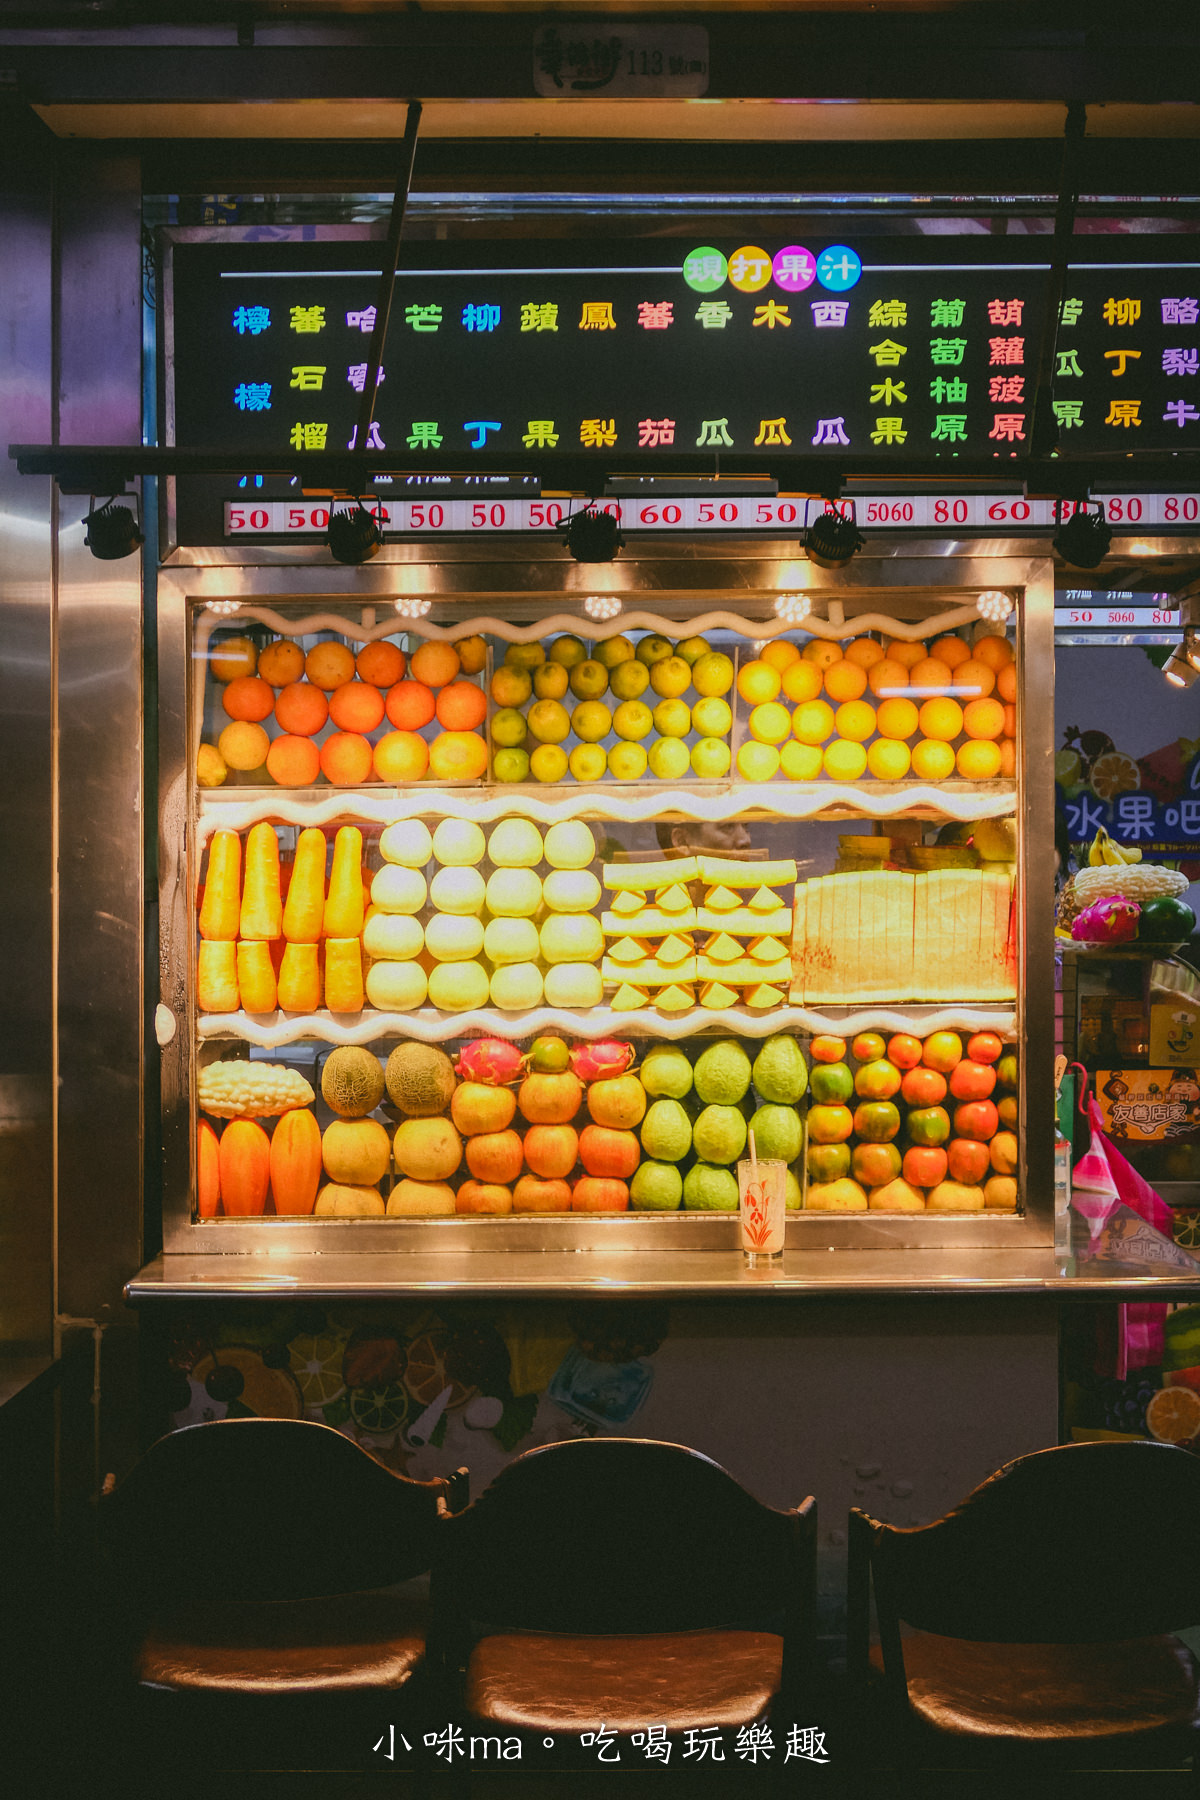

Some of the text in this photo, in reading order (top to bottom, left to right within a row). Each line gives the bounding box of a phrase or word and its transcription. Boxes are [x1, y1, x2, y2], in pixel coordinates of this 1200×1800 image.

[687, 254, 857, 284] 現打果汁
[290, 305, 329, 450] 蕃石榴
[405, 304, 444, 449] 芒果
[461, 303, 502, 449] 柳丁
[520, 302, 560, 448] 蘋果
[578, 302, 618, 448] 鳳梨
[637, 301, 676, 448] 蕃茄
[695, 300, 734, 447] 香瓜
[752, 299, 793, 446] 木瓜
[809, 300, 850, 446] 西瓜
[868, 299, 908, 445] 綜合水果
[929, 298, 969, 457] 葡萄柚原
[987, 298, 1027, 457] 葫蘿菠原
[1050, 298, 1084, 457] 苦瓜原
[1102, 297, 1142, 457] 柳丁原
[1160, 297, 1200, 456] 酪梨牛
[229, 510, 270, 529] 50
[288, 509, 330, 529] 50
[410, 505, 444, 528] 50
[471, 504, 506, 527] 50
[528, 504, 563, 527] 50
[640, 505, 682, 524] 60
[697, 504, 739, 522] 50
[755, 504, 797, 523] 50
[867, 502, 914, 522] 5060
[934, 500, 968, 523] 80
[988, 502, 1031, 520] 60
[1108, 498, 1142, 521] 80
[1164, 497, 1198, 521] 80
[1069, 610, 1172, 623] 50 5060 80
[1066, 796, 1200, 839] 水果吧
[1114, 1104, 1187, 1122] 友善店家
